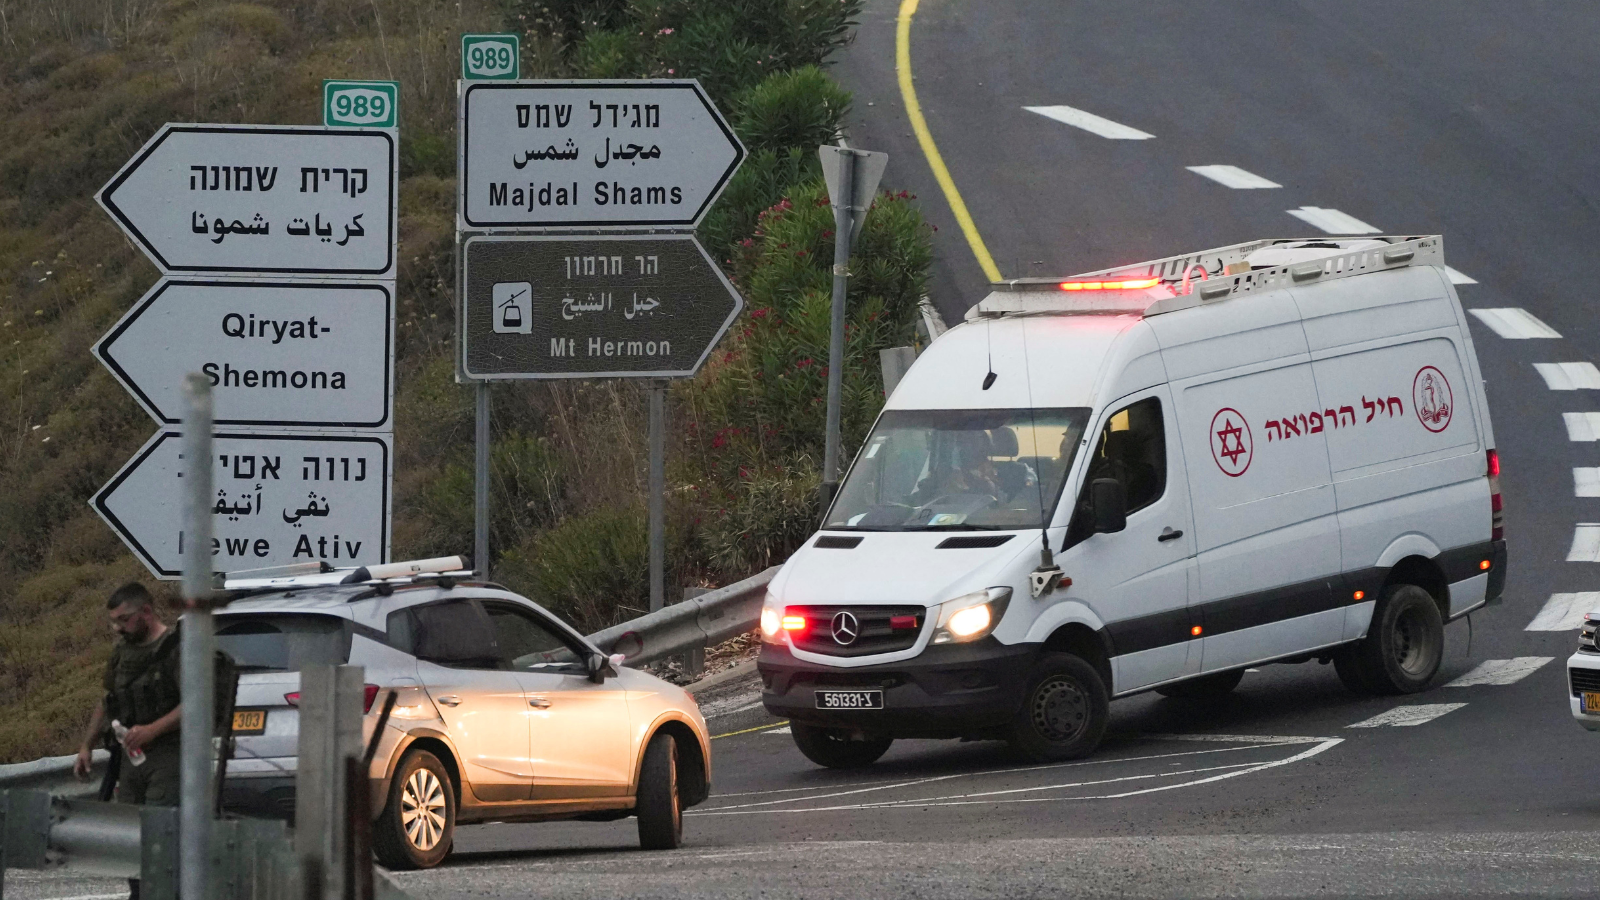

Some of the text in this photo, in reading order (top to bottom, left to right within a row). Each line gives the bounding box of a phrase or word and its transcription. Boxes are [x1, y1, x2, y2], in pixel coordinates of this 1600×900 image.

[472, 47, 510, 70] 989
[336, 95, 385, 118] 989
[516, 104, 572, 128] שמס
[513, 137, 661, 169] مجدل شمس
[190, 165, 368, 198] קרית שמונה
[489, 182, 682, 212] Majdal Shams
[192, 211, 365, 247] كريات شمونا
[565, 255, 659, 279] הר חרמון
[561, 292, 660, 320] جبل الشيخ
[222, 313, 331, 344] Qiryat-
[550, 337, 671, 357] Mt Hermon
[202, 363, 346, 390] Shemona
[1264, 395, 1404, 443] חיל הרפואה
[302, 456, 366, 481] נווה
[178, 531, 362, 559] ewe Ativ
